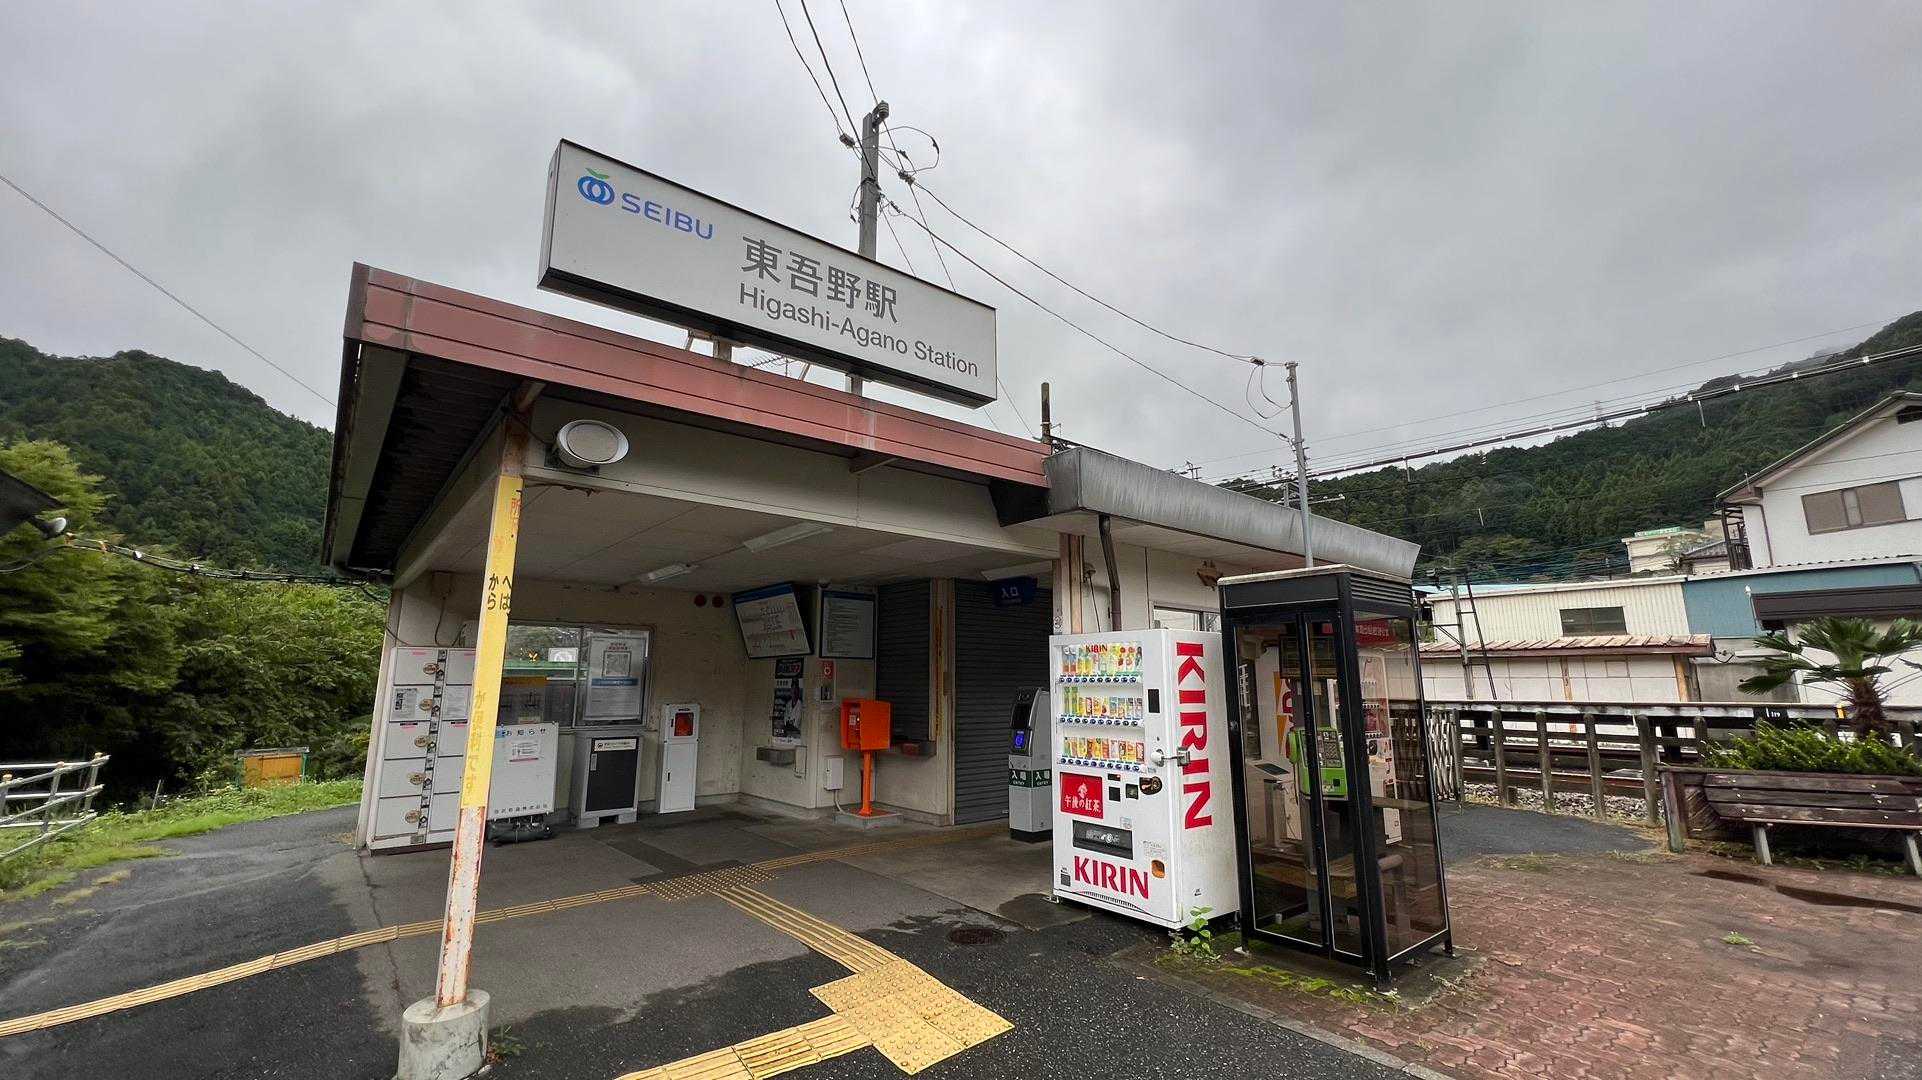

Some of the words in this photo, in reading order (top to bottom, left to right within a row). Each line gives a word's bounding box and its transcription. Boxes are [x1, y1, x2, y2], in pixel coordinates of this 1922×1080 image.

[621, 193, 713, 240] SEIBU
[740, 235, 898, 323] 東吾野駅
[740, 283, 908, 356] Higashi-Agano
[914, 340, 978, 378] Station
[1085, 643, 1108, 654] KIRIN
[1176, 642, 1212, 829] KIRIN
[1064, 795, 1100, 812] 午後の紅茶
[1074, 856, 1149, 899] KIRIN
